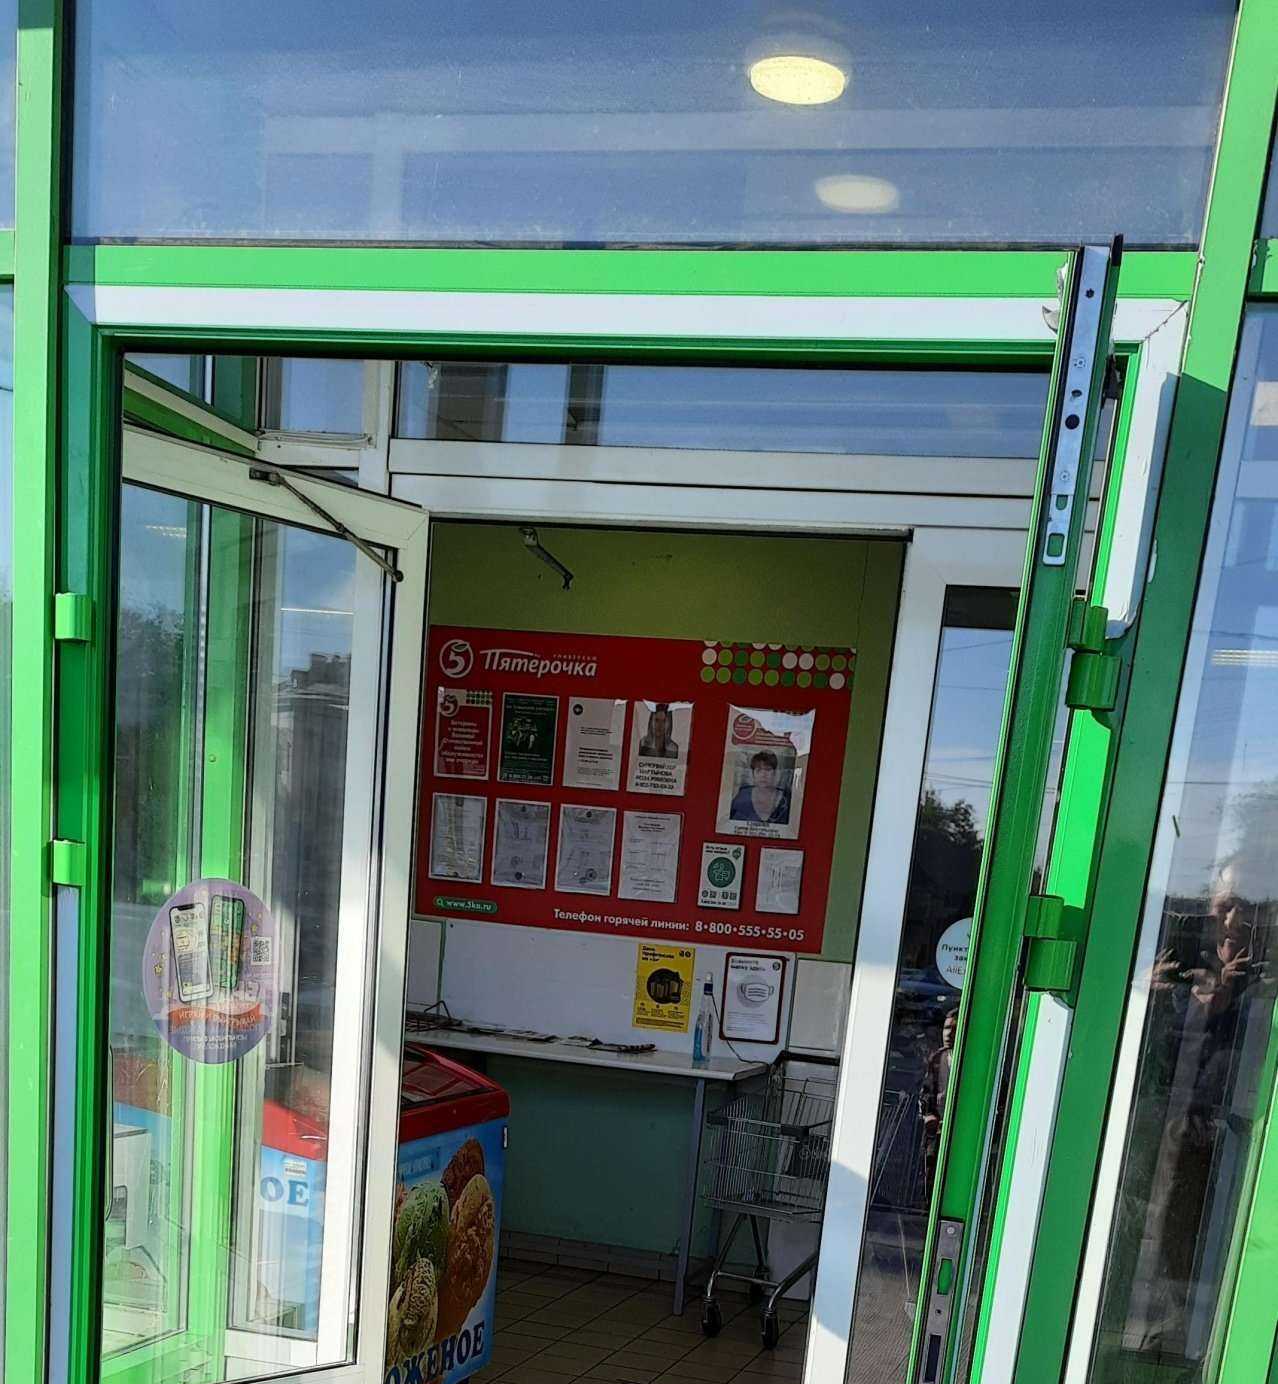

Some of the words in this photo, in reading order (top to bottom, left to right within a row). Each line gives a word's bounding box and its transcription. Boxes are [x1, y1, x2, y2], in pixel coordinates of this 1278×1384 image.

[553, 908, 601, 923] Телефон
[603, 914, 649, 927] горячей
[650, 920, 690, 931] линии:
